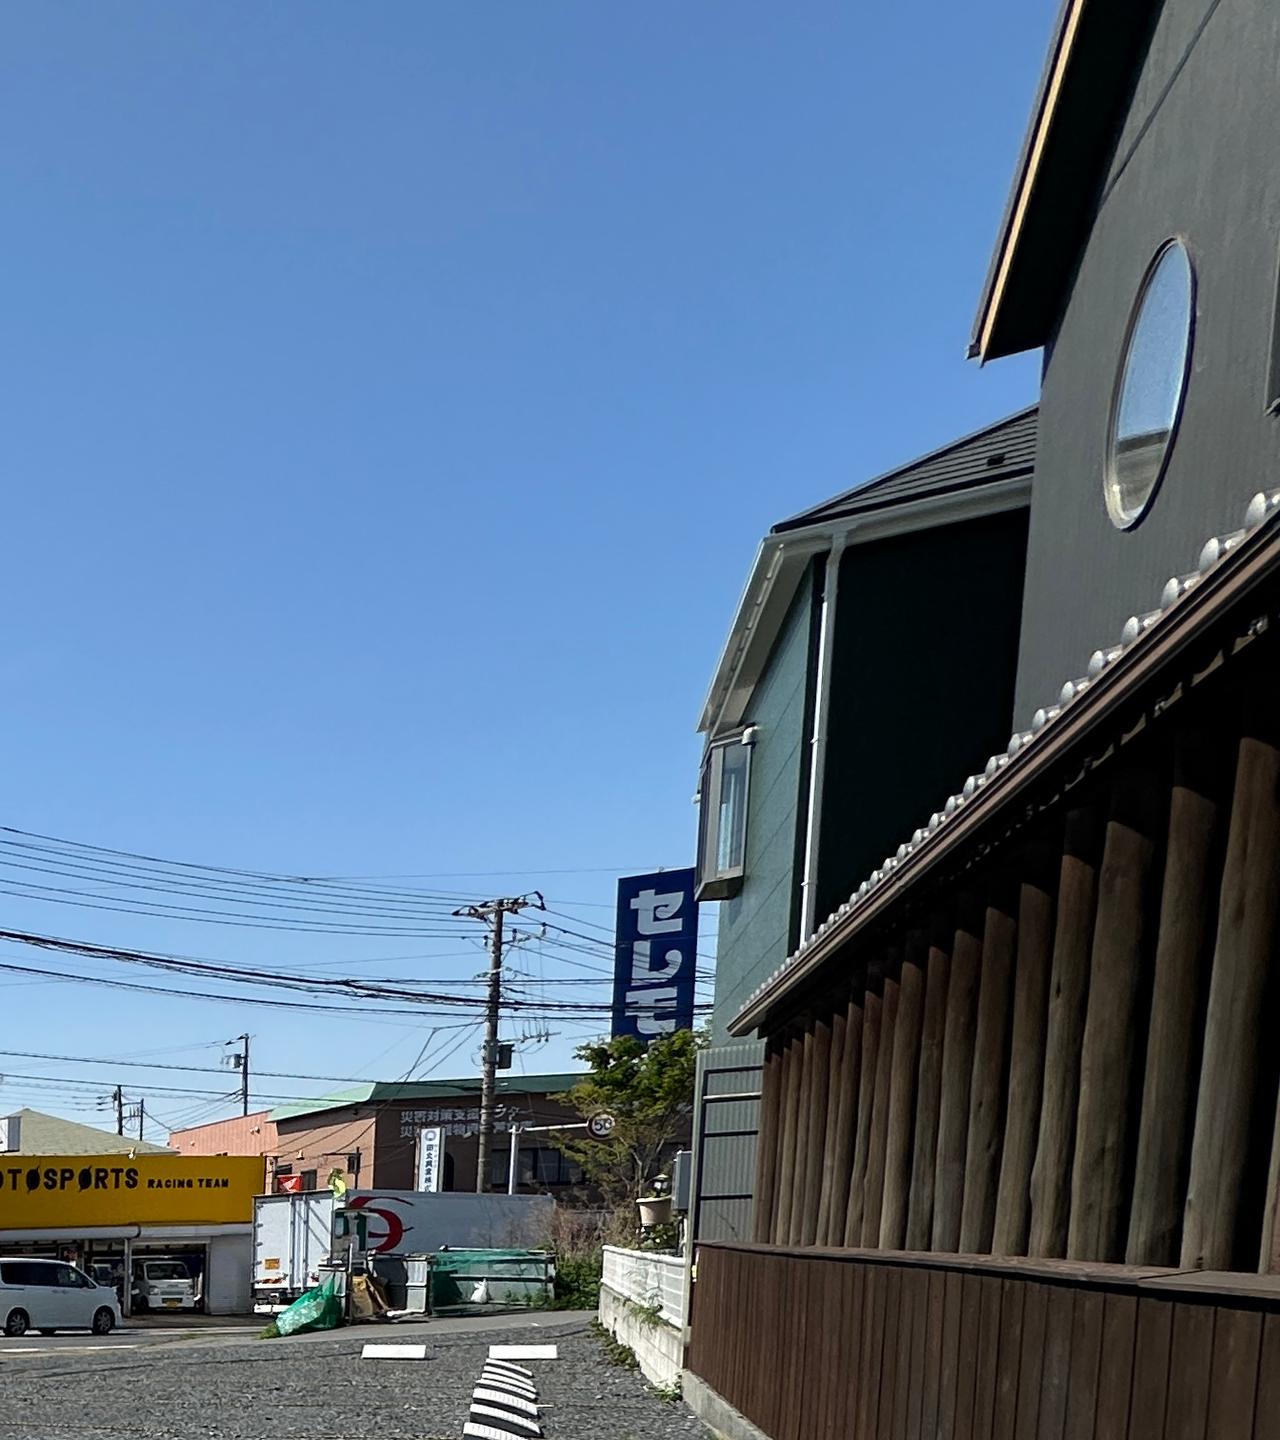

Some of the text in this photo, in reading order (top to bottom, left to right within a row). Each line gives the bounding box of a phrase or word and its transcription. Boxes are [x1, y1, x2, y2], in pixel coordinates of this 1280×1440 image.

[625, 888, 685, 1035] セレモ
[147, 1178, 193, 1189] RACING
[198, 1178, 229, 1188] TEAM
